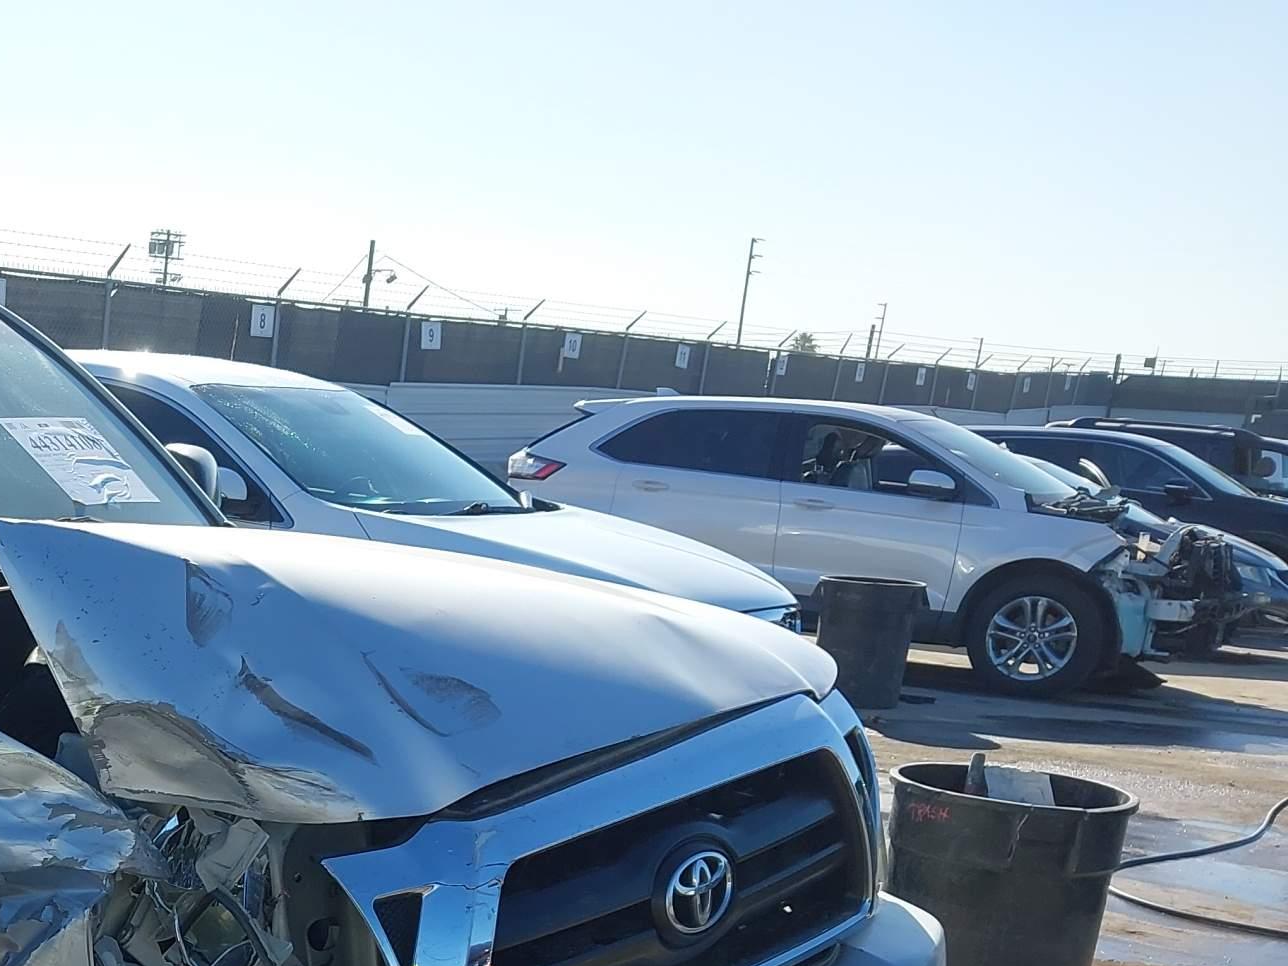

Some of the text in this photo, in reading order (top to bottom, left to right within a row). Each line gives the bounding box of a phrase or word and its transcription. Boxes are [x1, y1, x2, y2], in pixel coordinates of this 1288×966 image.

[259, 312, 266, 329] 8
[428, 328, 435, 343] 9
[568, 339, 578, 353] 10
